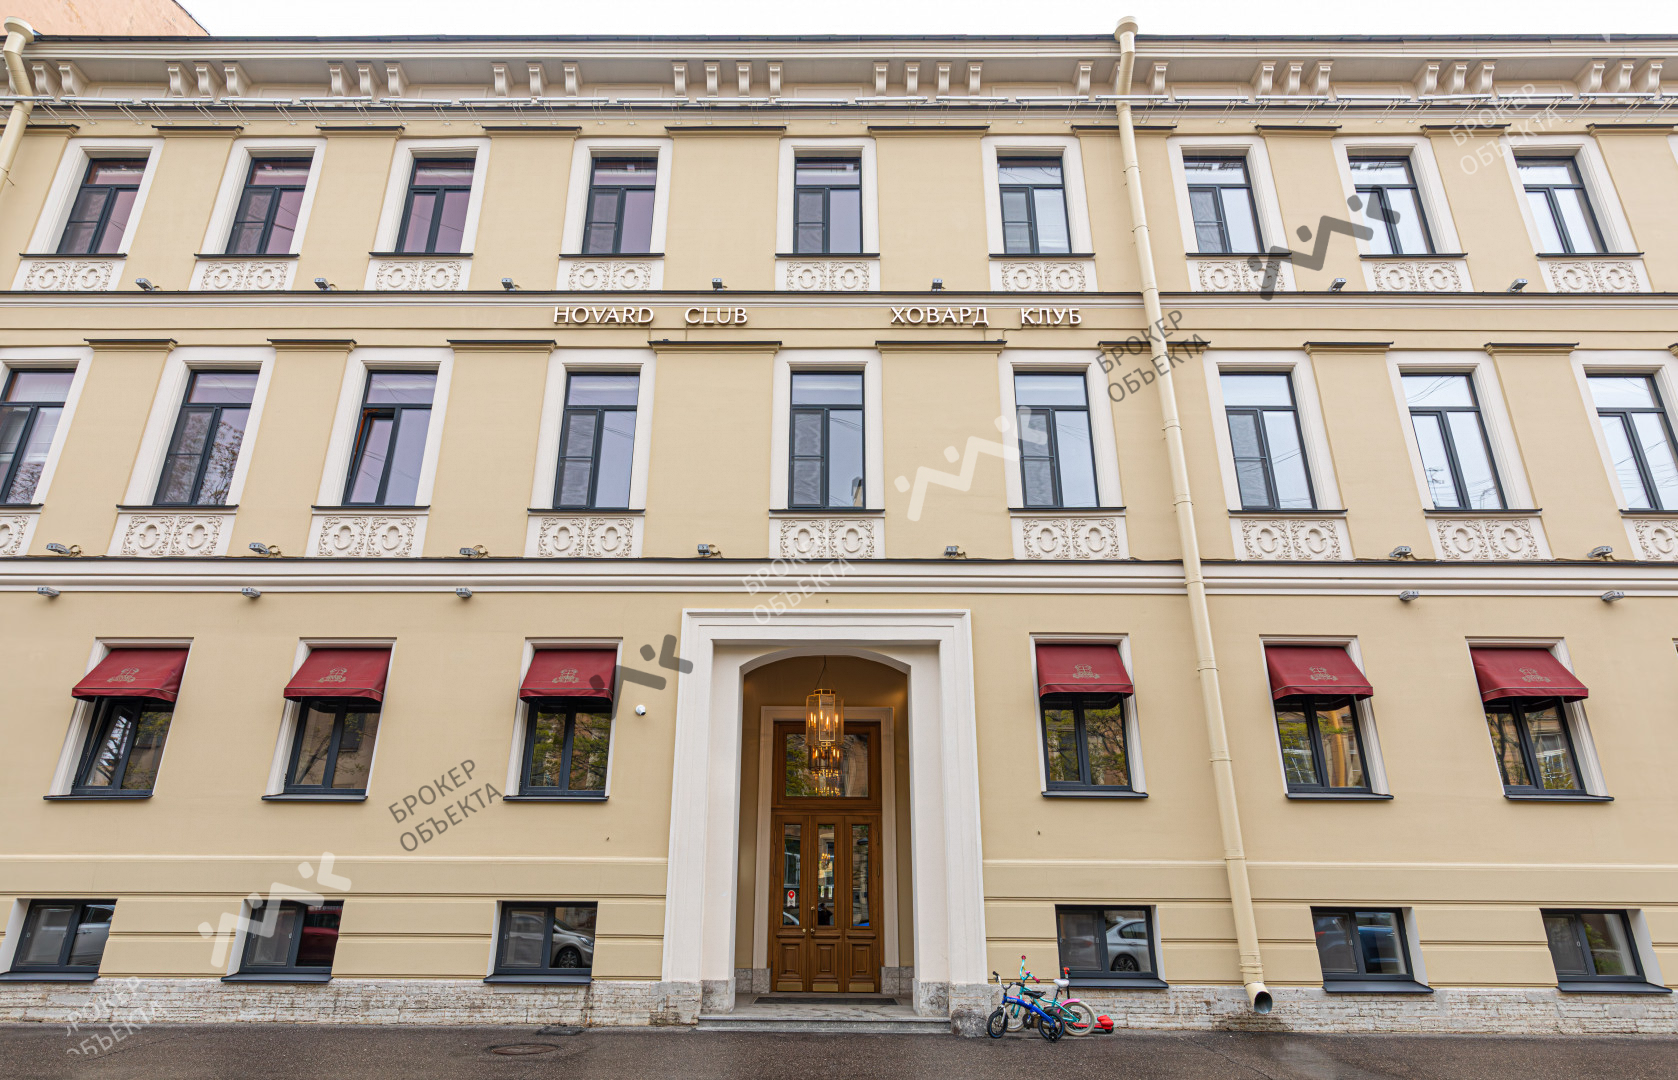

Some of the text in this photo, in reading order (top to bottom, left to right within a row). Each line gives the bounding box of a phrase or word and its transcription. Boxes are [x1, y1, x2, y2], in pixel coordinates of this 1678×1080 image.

[553, 306, 749, 325] HOVARD CLUB
[890, 307, 1082, 327] ХОВАРД КЛУБ
